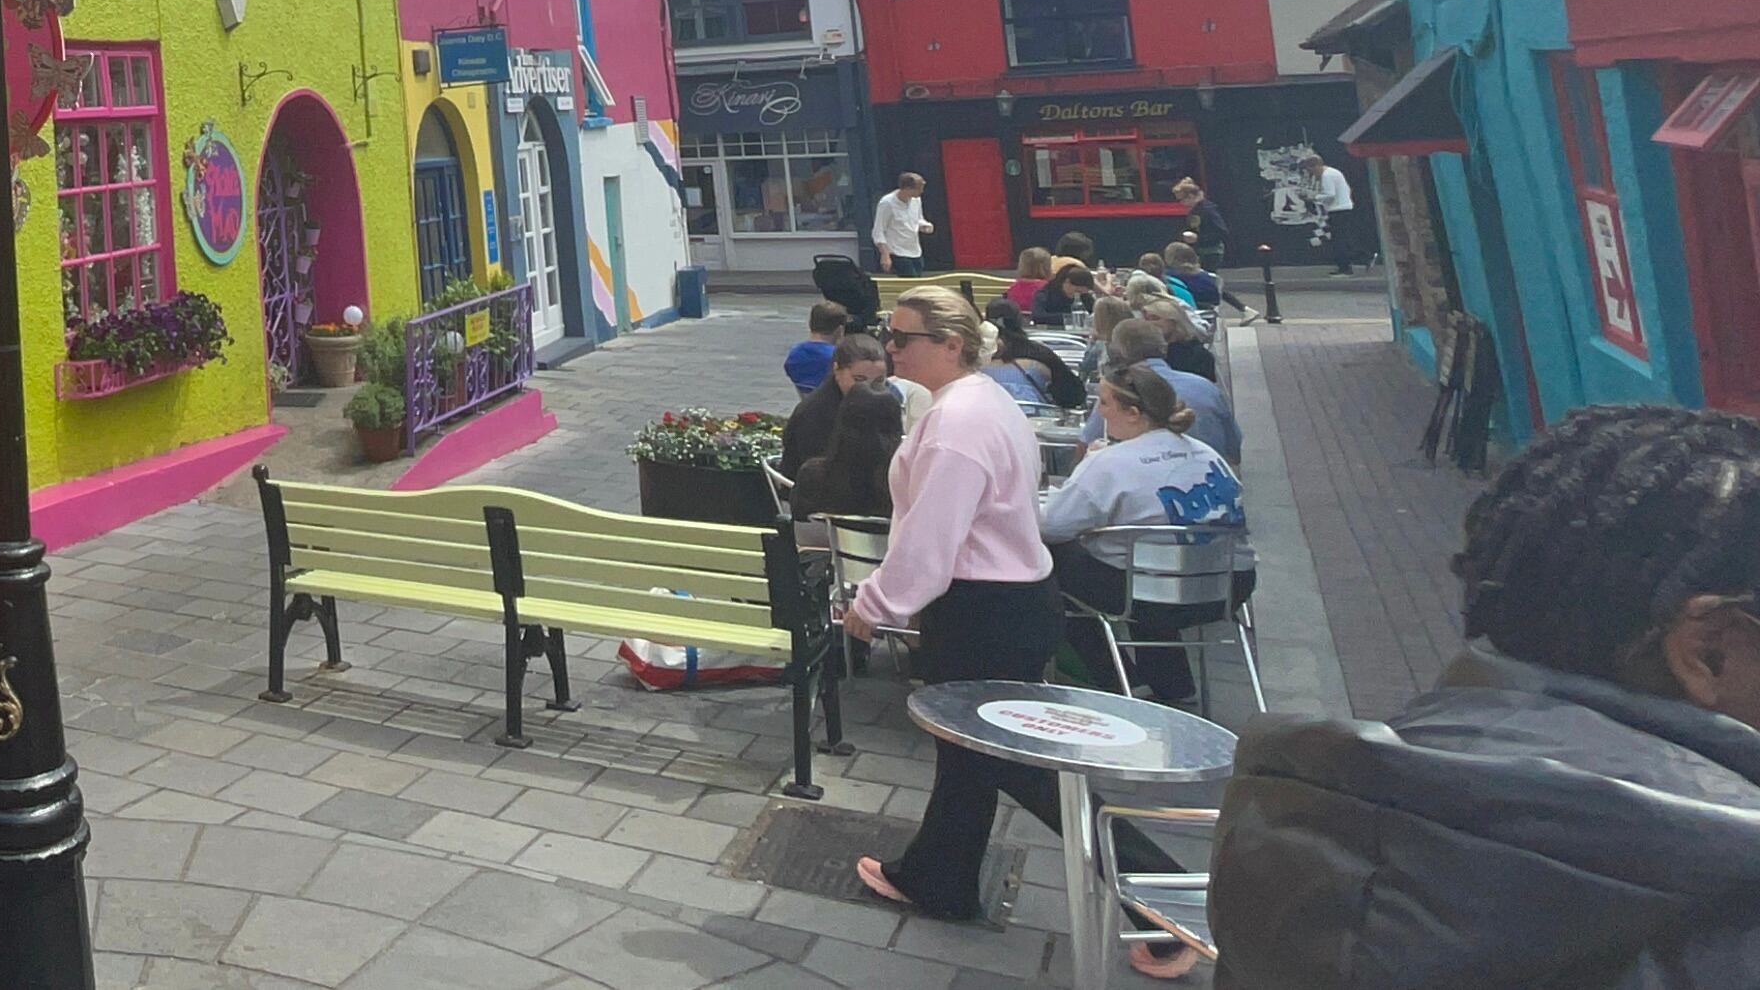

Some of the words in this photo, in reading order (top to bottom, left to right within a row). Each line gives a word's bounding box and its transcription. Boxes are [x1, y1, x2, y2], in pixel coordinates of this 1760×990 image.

[1039, 102, 1124, 121] Daltons
[1129, 99, 1174, 118] Bar
[999, 709, 1117, 740] CUSTOMERS
[1022, 723, 1069, 736] ONLY
